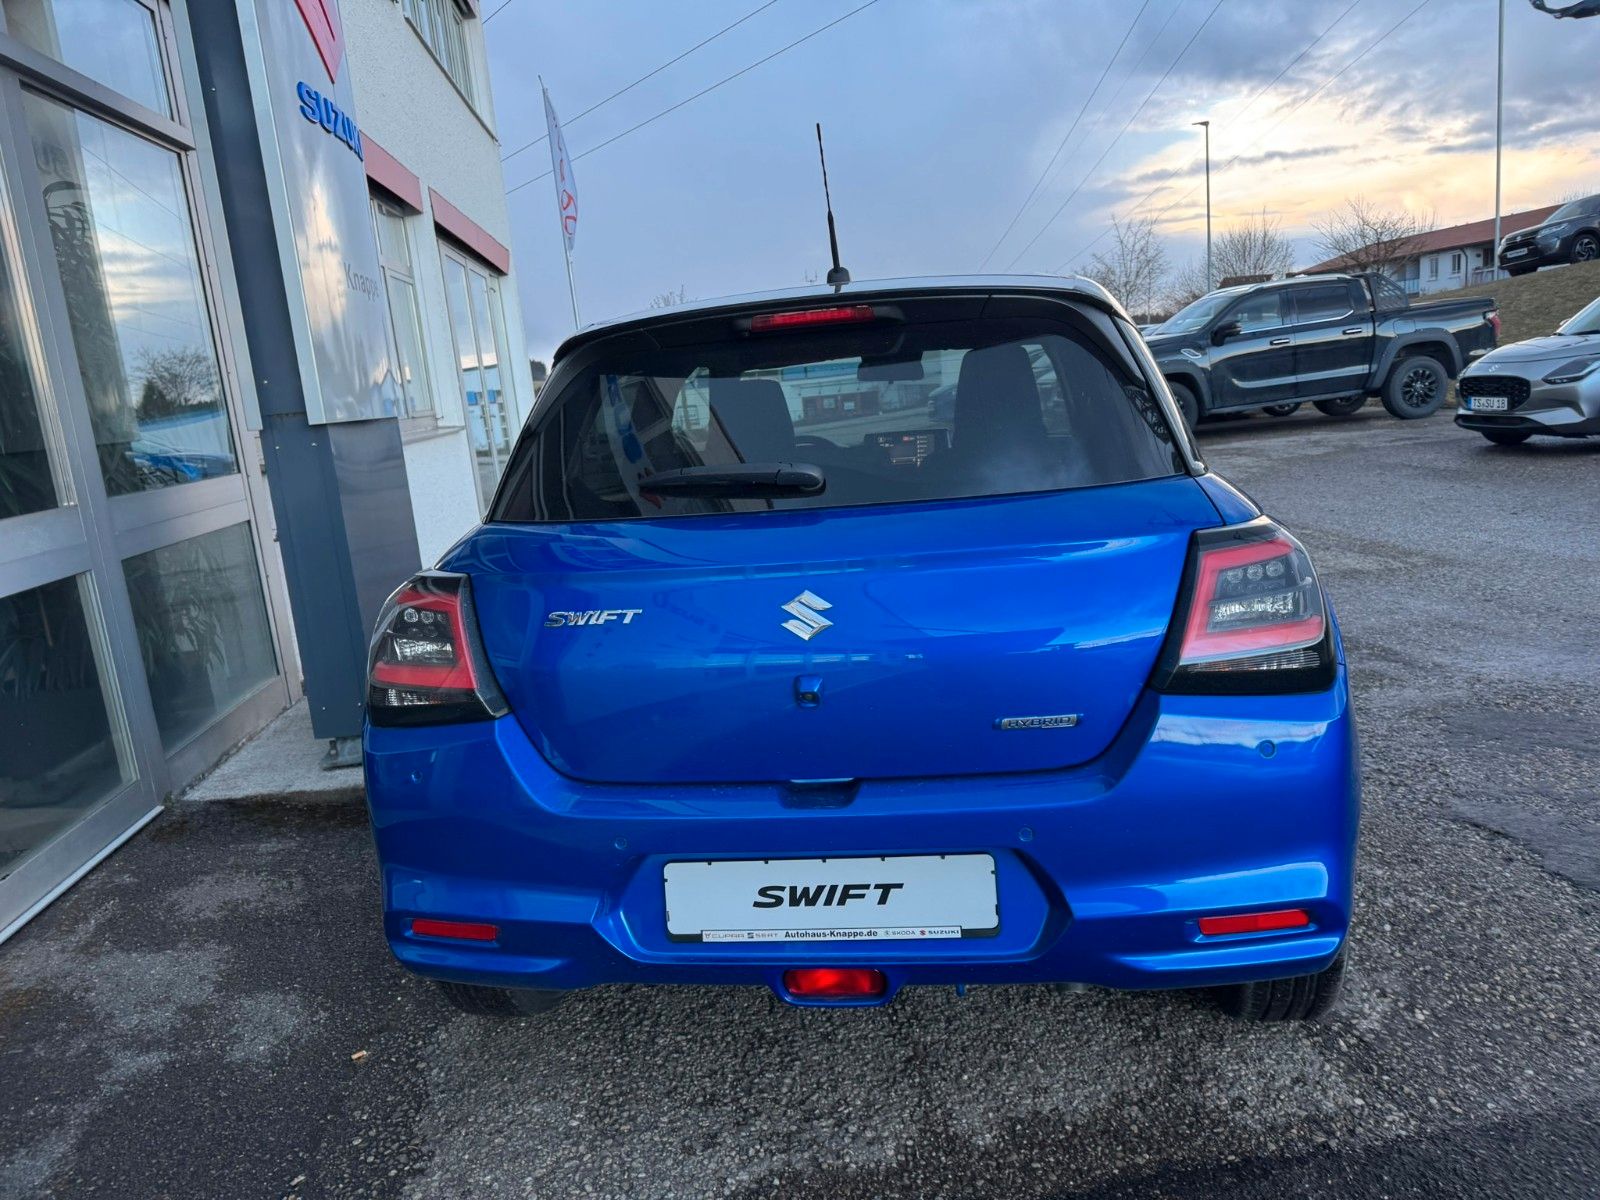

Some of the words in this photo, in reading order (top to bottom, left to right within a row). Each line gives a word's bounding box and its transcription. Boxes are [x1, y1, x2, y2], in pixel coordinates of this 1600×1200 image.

[544, 609, 643, 627] SWIFT
[1007, 716, 1072, 729] HYBRID
[752, 883, 904, 909] SWIFT
[784, 929, 878, 939] Autohaus-Knappe.de
